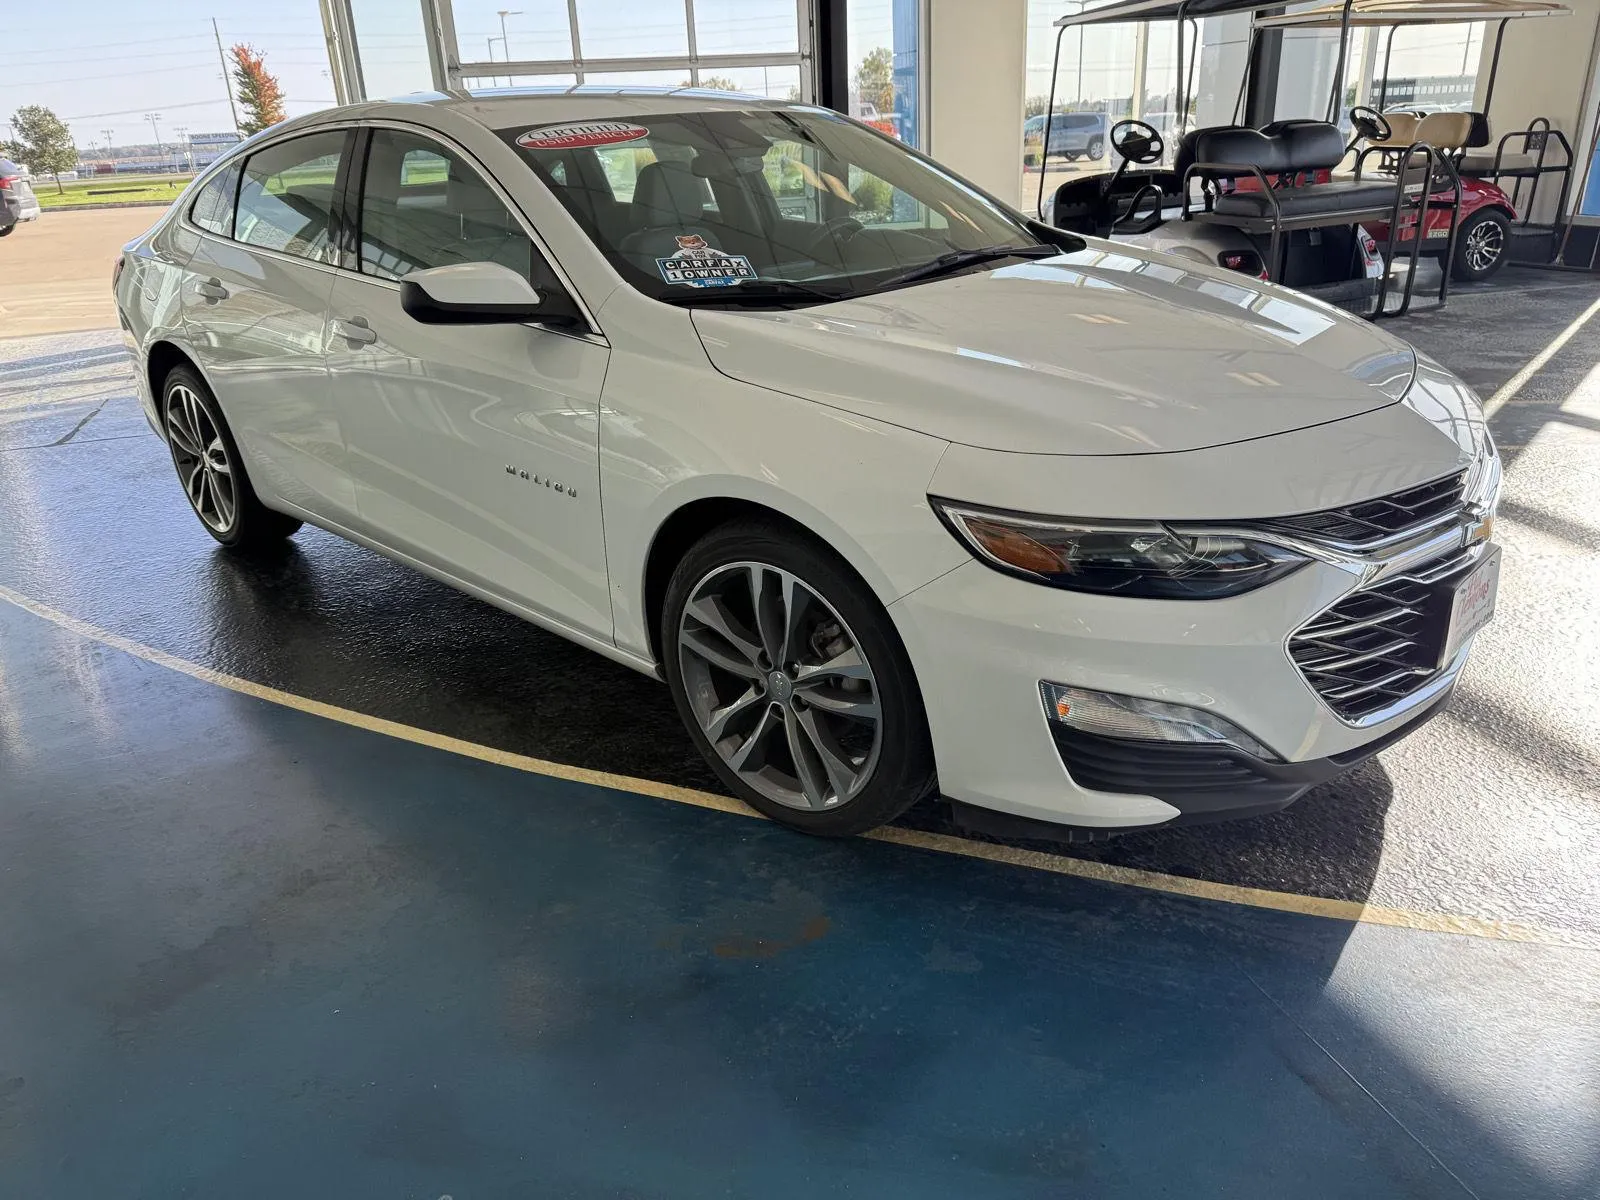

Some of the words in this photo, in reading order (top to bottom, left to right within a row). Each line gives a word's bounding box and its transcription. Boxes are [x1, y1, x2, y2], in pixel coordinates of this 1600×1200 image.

[528, 123, 630, 140] CERTIFIED
[536, 136, 575, 147] USED
[577, 131, 639, 141] VEHICLE
[665, 258, 746, 269] CARFAX
[670, 270, 681, 279] 1
[684, 268, 750, 279] OWNER
[505, 464, 577, 498] MALIBU
